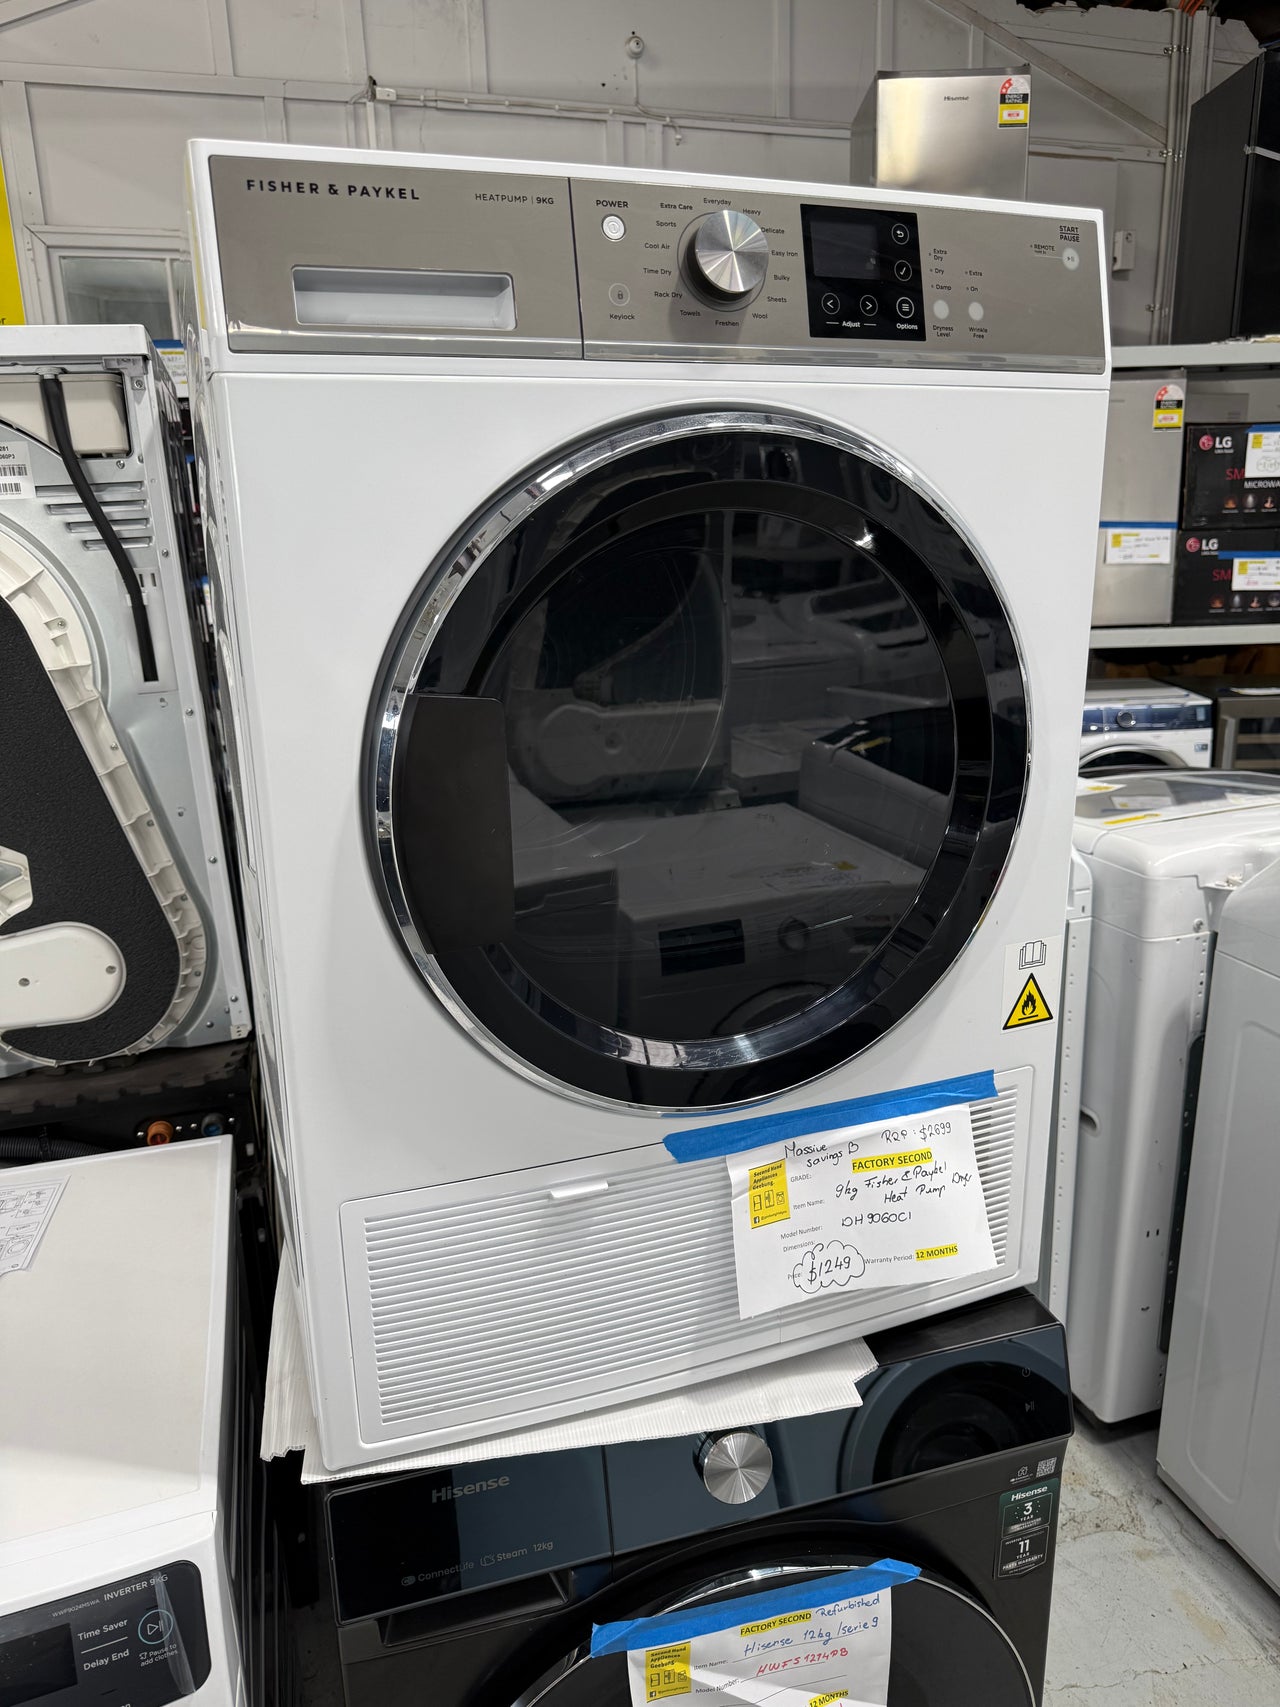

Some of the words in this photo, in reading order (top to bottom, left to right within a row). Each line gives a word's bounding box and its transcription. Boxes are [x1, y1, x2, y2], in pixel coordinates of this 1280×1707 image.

[247, 180, 320, 194] FISHER
[329, 184, 339, 195] &
[348, 185, 420, 200] PAYKEL
[474, 193, 528, 204] HEATPUMP
[536, 196, 554, 205] 9KG
[596, 200, 628, 208] POWER
[704, 198, 731, 206] Everyday
[742, 208, 761, 216] Heavy
[660, 268, 672, 276] Dry
[897, 322, 918, 330] Options
[1215, 436, 1232, 448] LG
[1201, 539, 1218, 551] LG
[919, 1122, 951, 1142] $2699
[852, 1157, 895, 1170] FACTORY
[898, 1150, 933, 1164] SECOND
[753, 1172, 778, 1184] Appliances
[754, 1167, 770, 1178] Second
[790, 1174, 812, 1182] GRADE:
[835, 1181, 858, 1200] 9kg
[884, 1186, 907, 1204] Heat
[807, 1200, 825, 1208] Name:
[780, 1232, 798, 1240] Model
[799, 1225, 823, 1235] Number:
[783, 1240, 816, 1252] Dimensions:
[864, 1257, 892, 1265] Warranty
[894, 1254, 914, 1262] Period:
[926, 1246, 958, 1257] MONTHS
[807, 1256, 850, 1285] $1249
[432, 1476, 510, 1503] Hisense
[1011, 1486, 1048, 1501] Hisense
[1023, 1502, 1032, 1515] 3
[1020, 1514, 1034, 1522] YEAR
[1019, 1540, 1029, 1553] 11
[418, 1562, 474, 1582] ConnectLife
[497, 1548, 527, 1561] Steam
[533, 1541, 554, 1552] 12kg
[104, 1581, 148, 1601] INVERTER
[150, 1574, 169, 1586] 9KG
[740, 1620, 776, 1635] FACTORY
[778, 1613, 812, 1625] SECOND
[815, 1594, 880, 1617] Refurbished
[78, 1628, 100, 1641] Time
[102, 1619, 128, 1633] Saver
[149, 1647, 168, 1657] Pause
[651, 1649, 671, 1657] Second
[745, 1637, 793, 1656] Hisense
[83, 1658, 109, 1671] Delay
[112, 1649, 129, 1661] End
[140, 1657, 154, 1667] add
[154, 1650, 178, 1663] clothes
[716, 1679, 739, 1692] Number:
[818, 1690, 848, 1706] MONTHS
